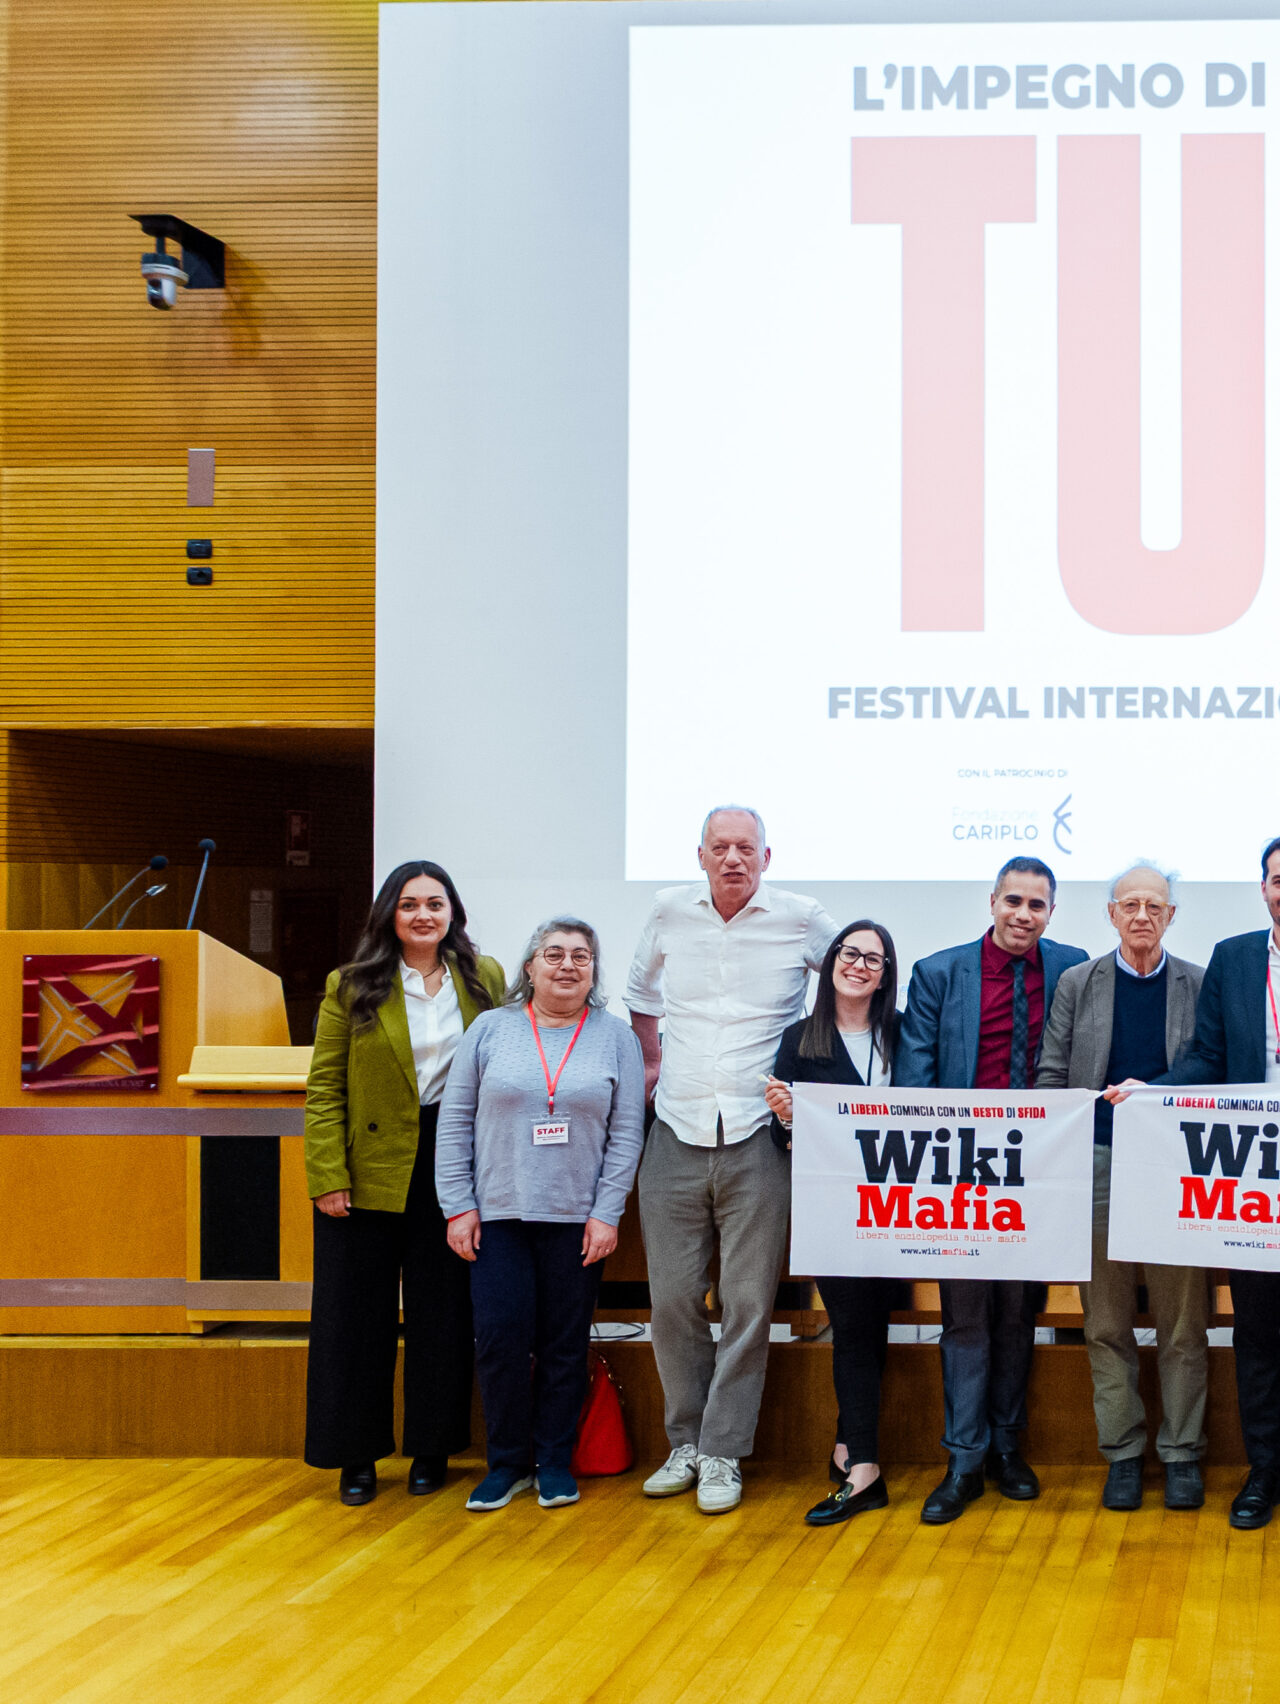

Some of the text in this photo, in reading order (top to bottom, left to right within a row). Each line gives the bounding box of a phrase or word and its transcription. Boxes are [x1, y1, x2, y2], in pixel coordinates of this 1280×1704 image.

[853, 61, 1266, 111] L'IMPEGNO DI
[828, 686, 1030, 720] FESTIVAL
[957, 769, 1069, 778] CON IL PATROCINIO DI
[952, 824, 1039, 840] CARIPLO
[838, 1102, 849, 1115] LA
[890, 1104, 935, 1117] COMINCIA
[937, 1106, 956, 1117] CON
[958, 1107, 971, 1118] UN
[973, 1107, 1004, 1118] GESTO
[1006, 1107, 1016, 1119] DI
[1017, 1107, 1046, 1119] SFIDA
[1163, 1096, 1174, 1106] LA
[1217, 1098, 1264, 1111] COMINCIA
[536, 1127, 566, 1135] STAFF
[855, 1128, 1024, 1187] Wiki
[857, 1183, 1025, 1232] Mafia
[1177, 1222, 1212, 1232] libera
[855, 1231, 1027, 1243] libera enciclopedia sulle mafie
[900, 1247, 980, 1256] www.wikimafia.it
